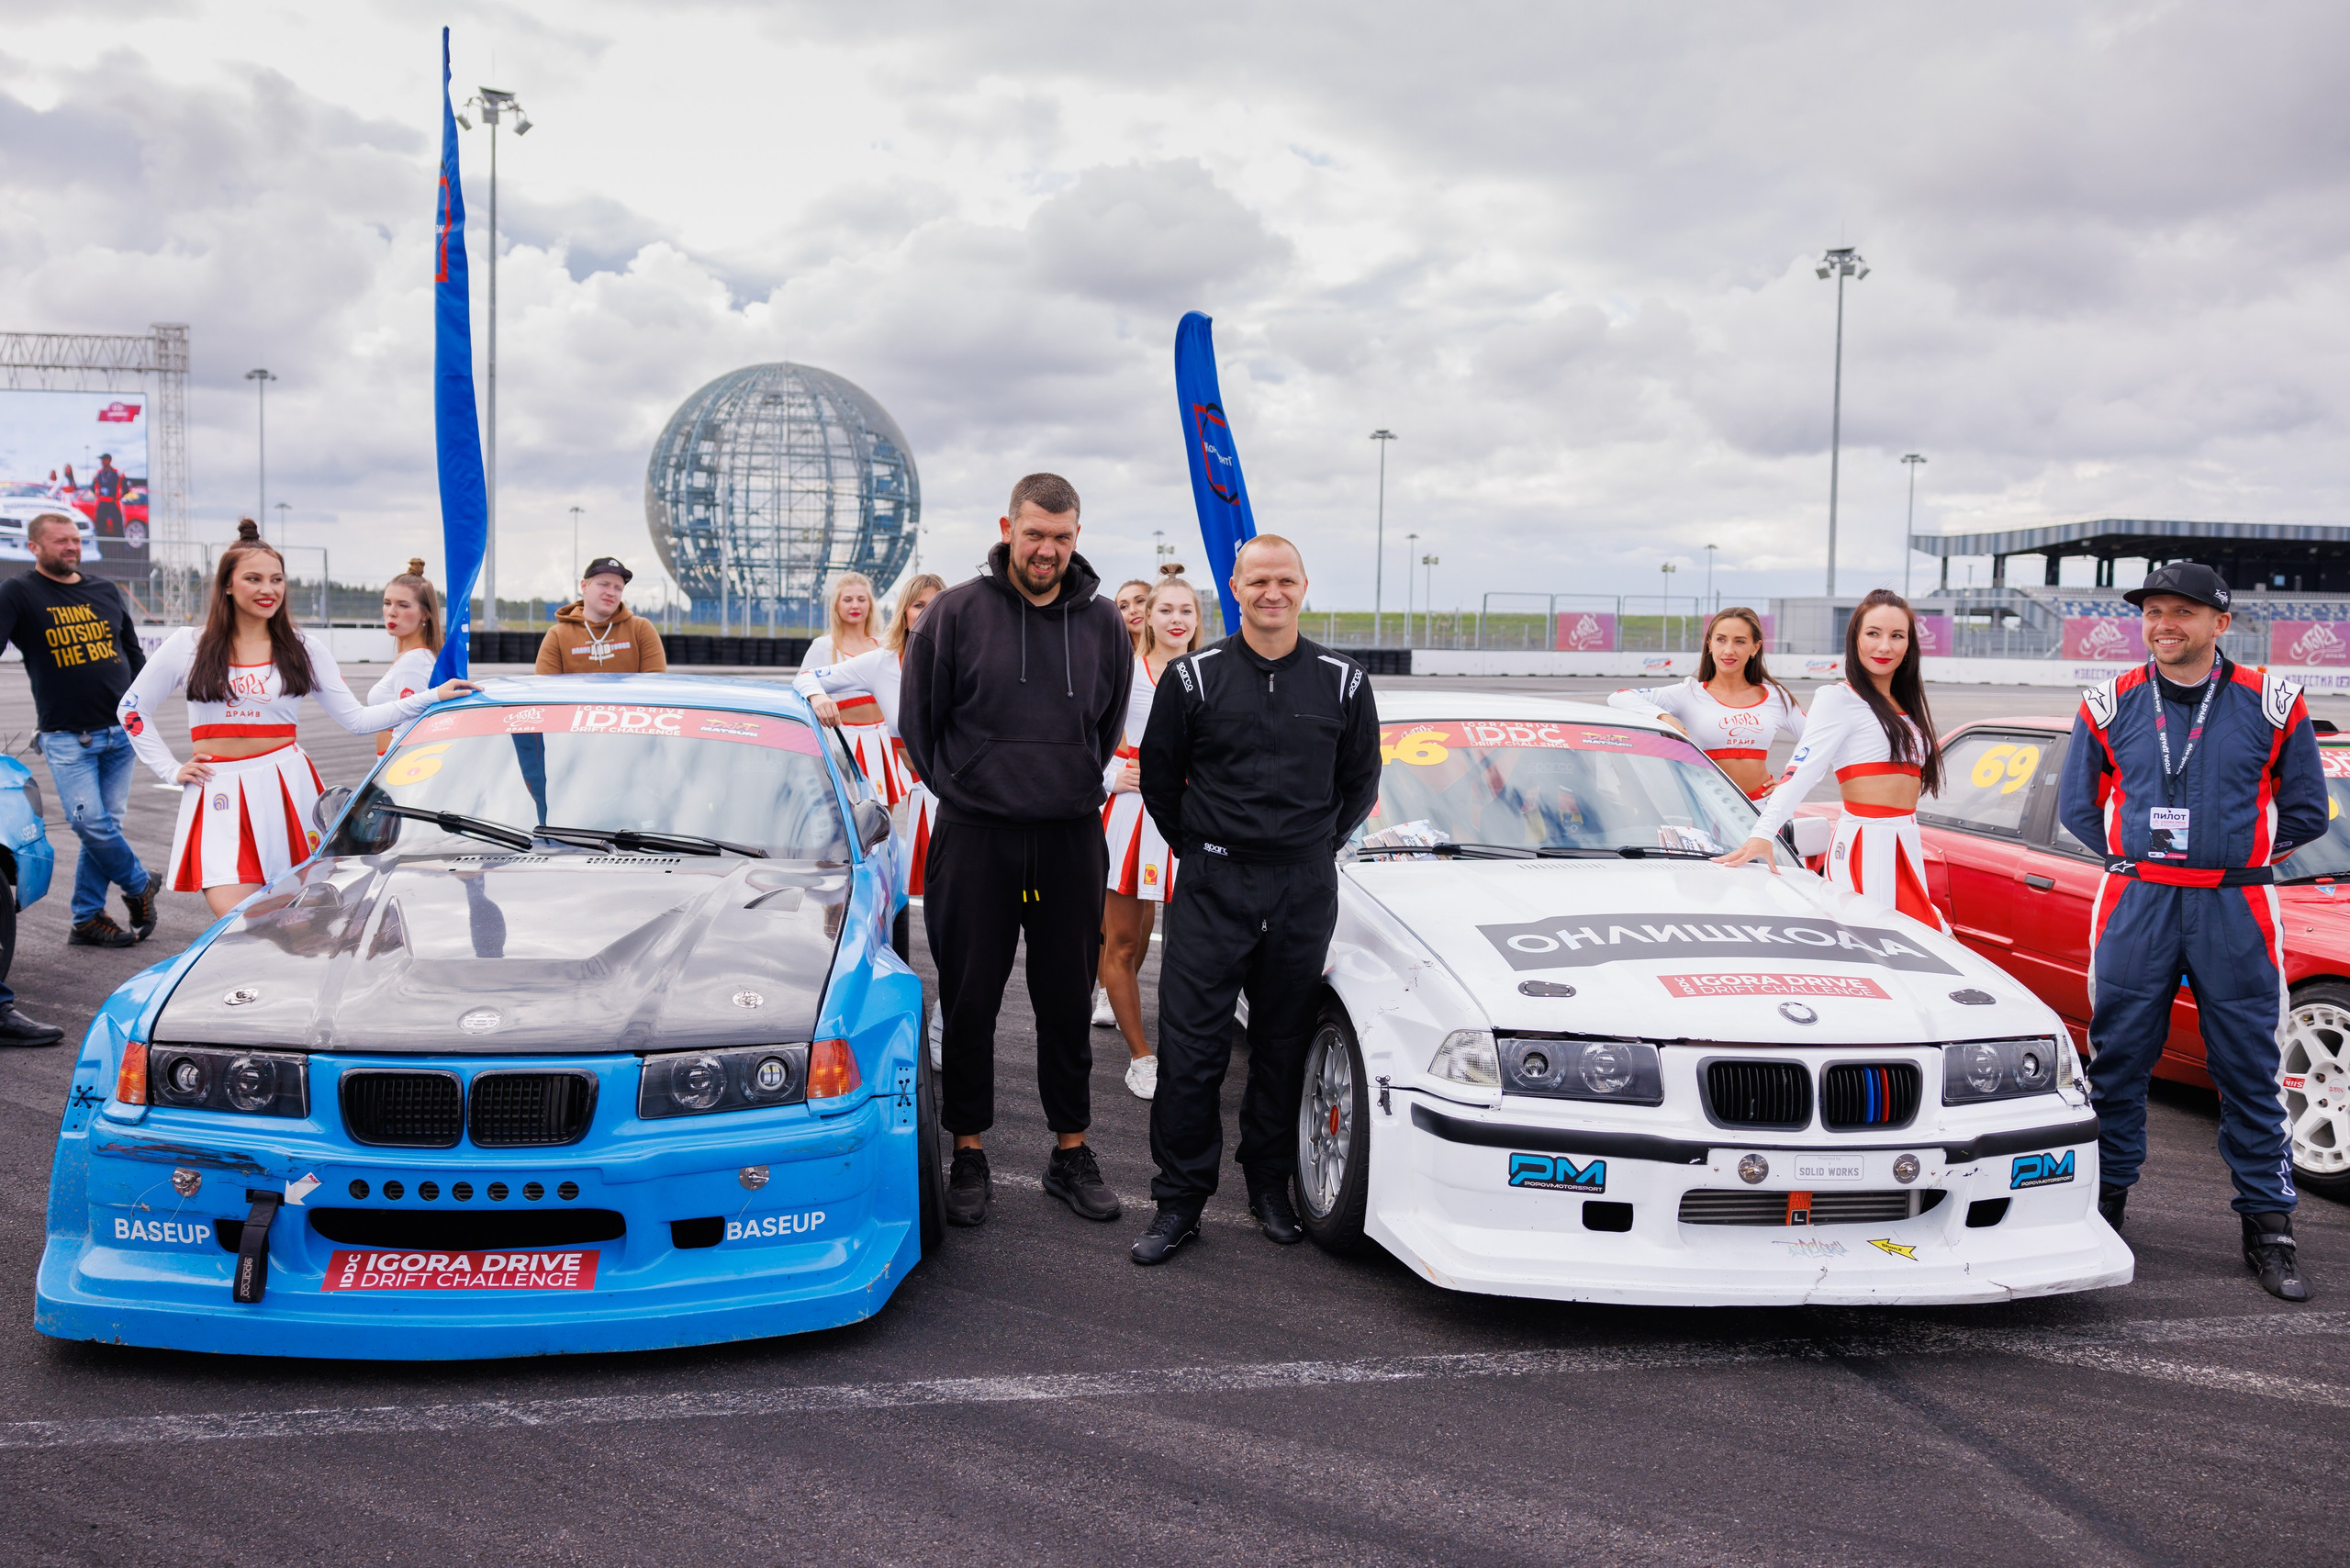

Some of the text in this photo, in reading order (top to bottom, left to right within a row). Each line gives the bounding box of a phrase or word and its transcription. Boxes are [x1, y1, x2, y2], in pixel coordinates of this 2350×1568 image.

[46, 603, 97, 625] THINK
[45, 620, 113, 647] OUTSIDE
[50, 644, 86, 668] THE
[86, 640, 118, 661] BOX
[1176, 661, 1193, 693] sparco
[1348, 668, 1362, 700] sparco
[571, 711, 684, 730] IDDC
[636, 706, 685, 715] DRIVE
[2197, 701, 2210, 724] ДРАЙВ
[609, 726, 682, 735] CHALLENGE
[1463, 726, 1565, 744] IDDC
[2160, 732, 2170, 754] ДРАЙВ
[386, 744, 453, 787] 6
[1972, 745, 2040, 795] 69
[1203, 842, 1228, 856] sparc
[1674, 977, 1697, 995] IDDC
[1691, 975, 1868, 989] IGORA DRIVE
[1699, 985, 1876, 996] DRIFT CHALLENGE
[1510, 1154, 1605, 1185] PM
[1799, 1167, 1859, 1176] SOLID WORKS
[2011, 1151, 2074, 1187] PM
[1524, 1181, 1603, 1192] POPOVMOTORSPORT
[2021, 1176, 2073, 1187] POPOVMOTORSPORT
[115, 1217, 210, 1244] BASEUP
[727, 1211, 826, 1240] BASEUP
[339, 1253, 362, 1287] IDDC
[365, 1253, 583, 1271] IGORA DRIVE
[241, 1257, 252, 1297] sparco
[360, 1272, 579, 1287] DRIFT CHALLENGE
